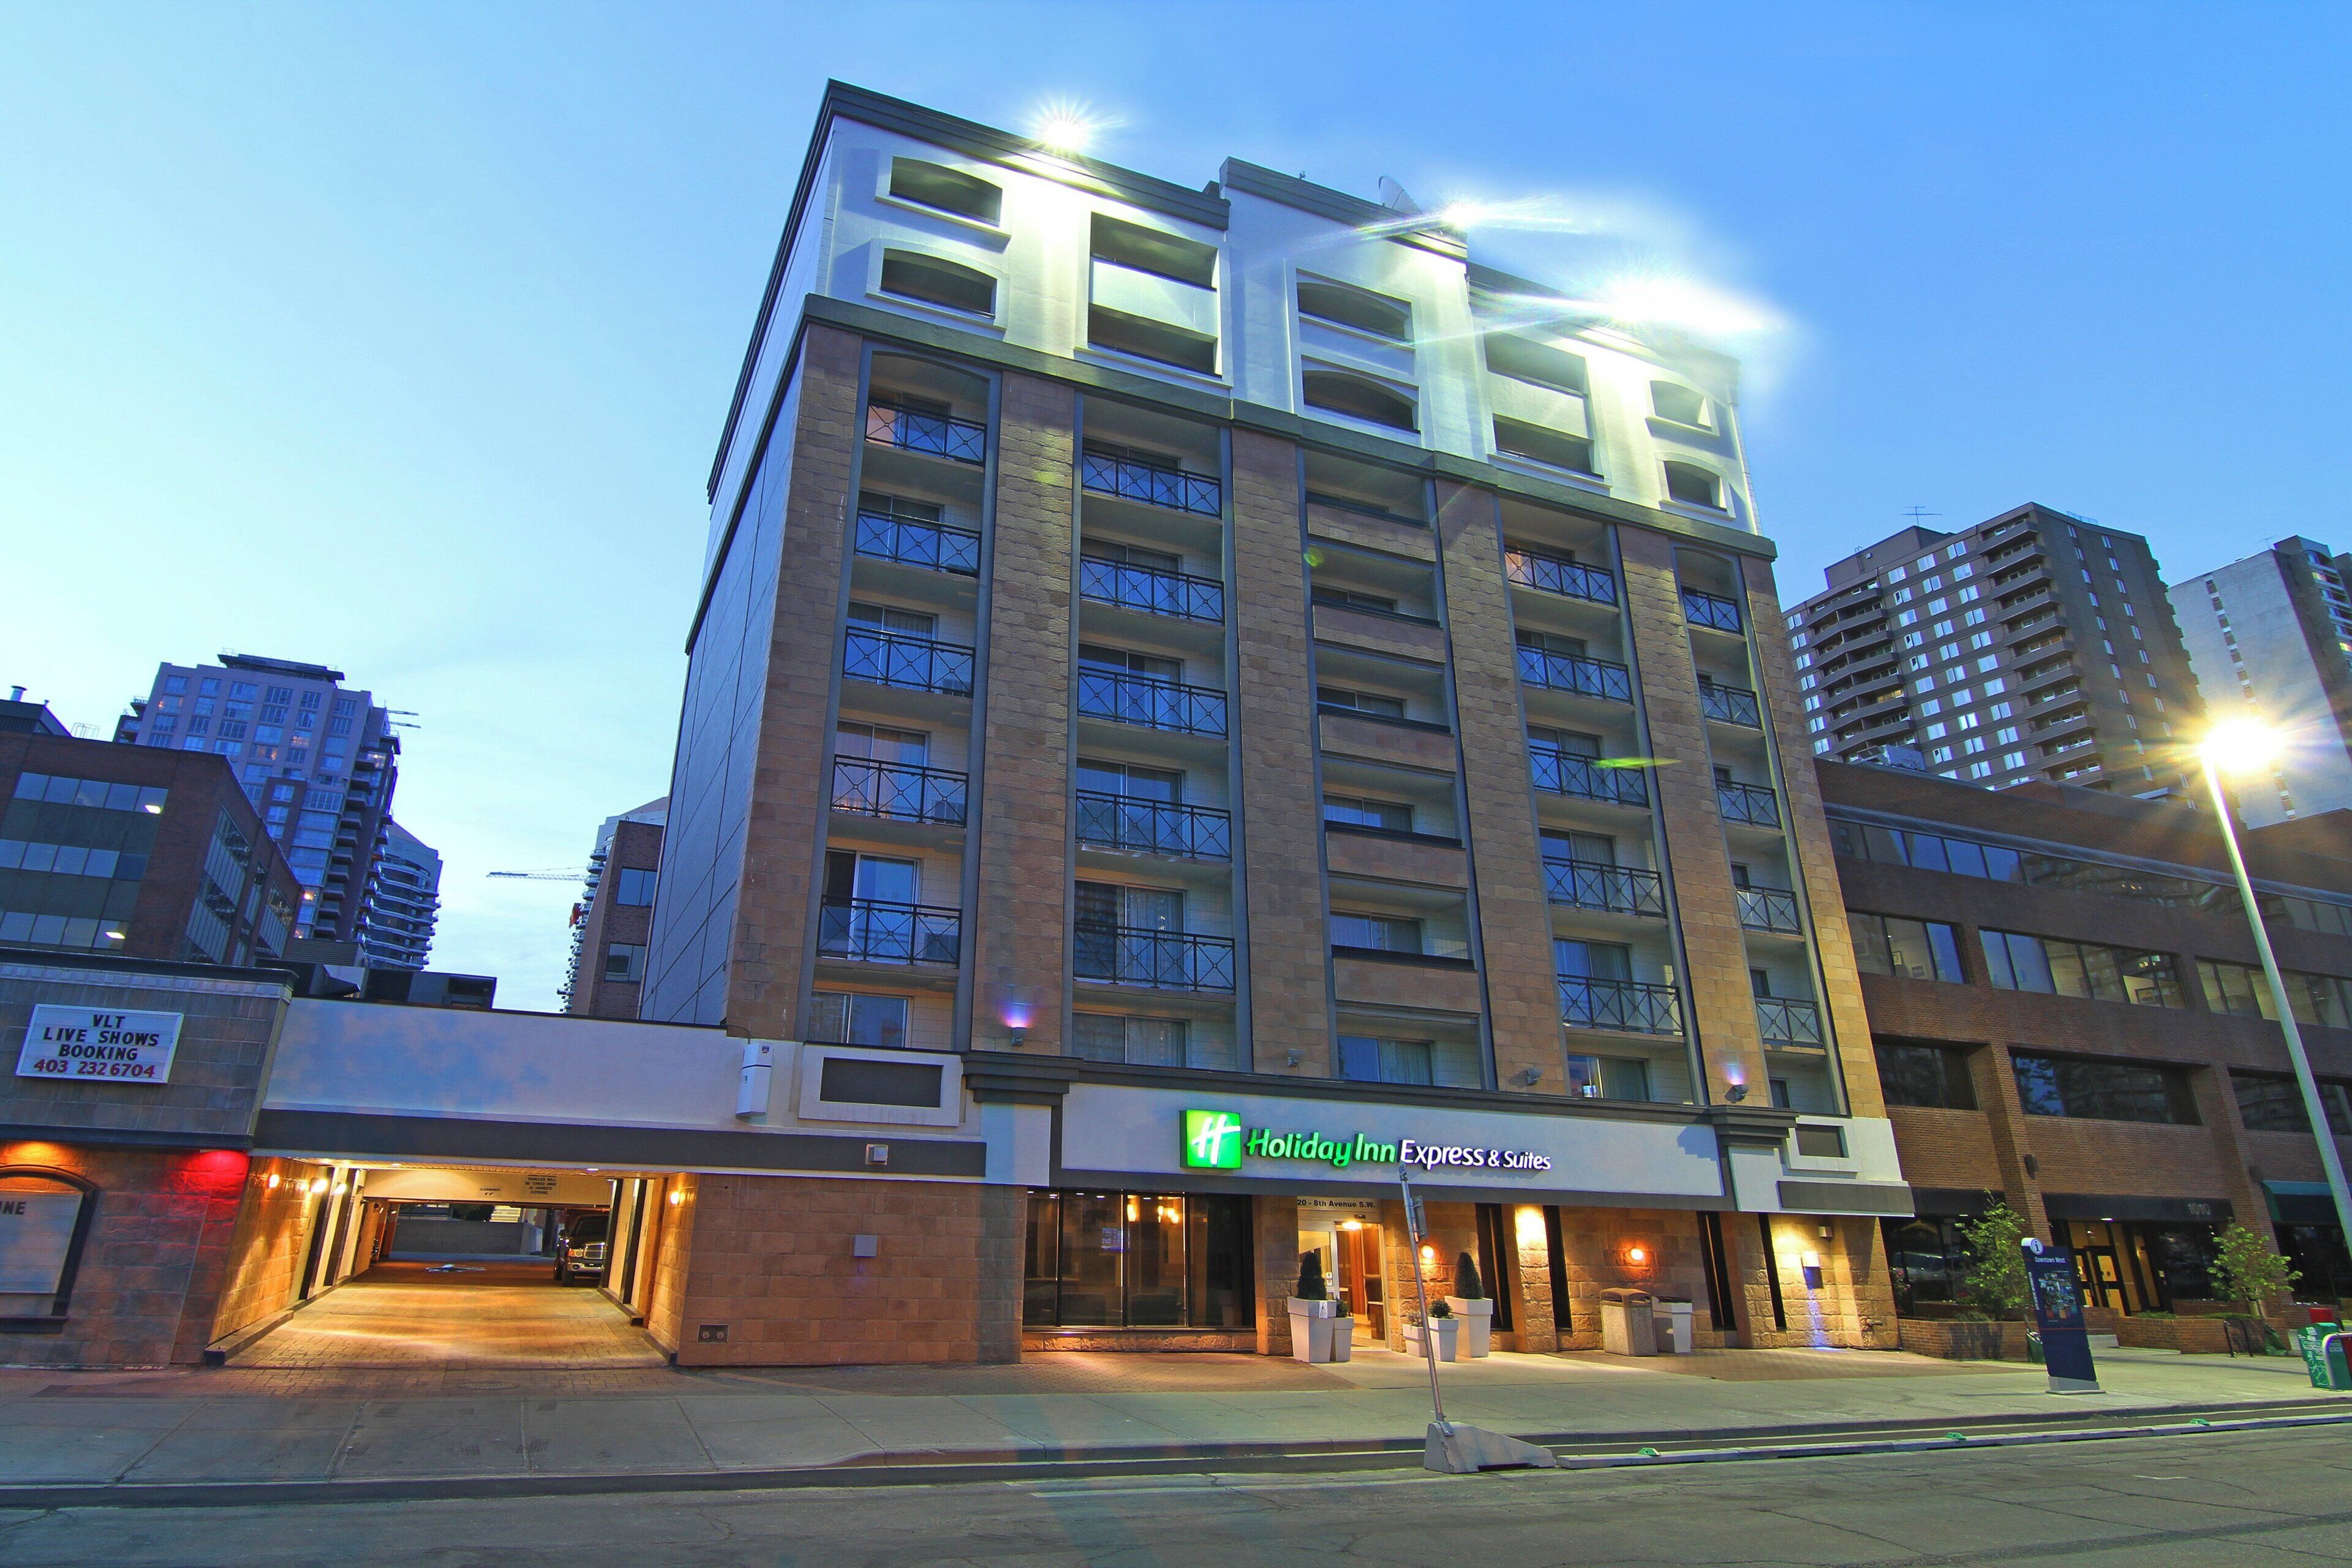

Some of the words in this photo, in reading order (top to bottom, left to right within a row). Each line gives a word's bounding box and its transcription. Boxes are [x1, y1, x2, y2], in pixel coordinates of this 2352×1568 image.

[93, 1014, 126, 1028] VLT
[43, 1027, 88, 1042] LIVE
[98, 1030, 159, 1046] SHOWS
[58, 1044, 138, 1061] BOOKING
[34, 1059, 69, 1073] 403
[1246, 1128, 1352, 1167] Holiday
[1355, 1133, 1396, 1163] Inn
[1400, 1139, 1485, 1170] Express
[1487, 1149, 1500, 1167] &
[1502, 1150, 1551, 1170] Suites
[0, 1200, 26, 1215] NE
